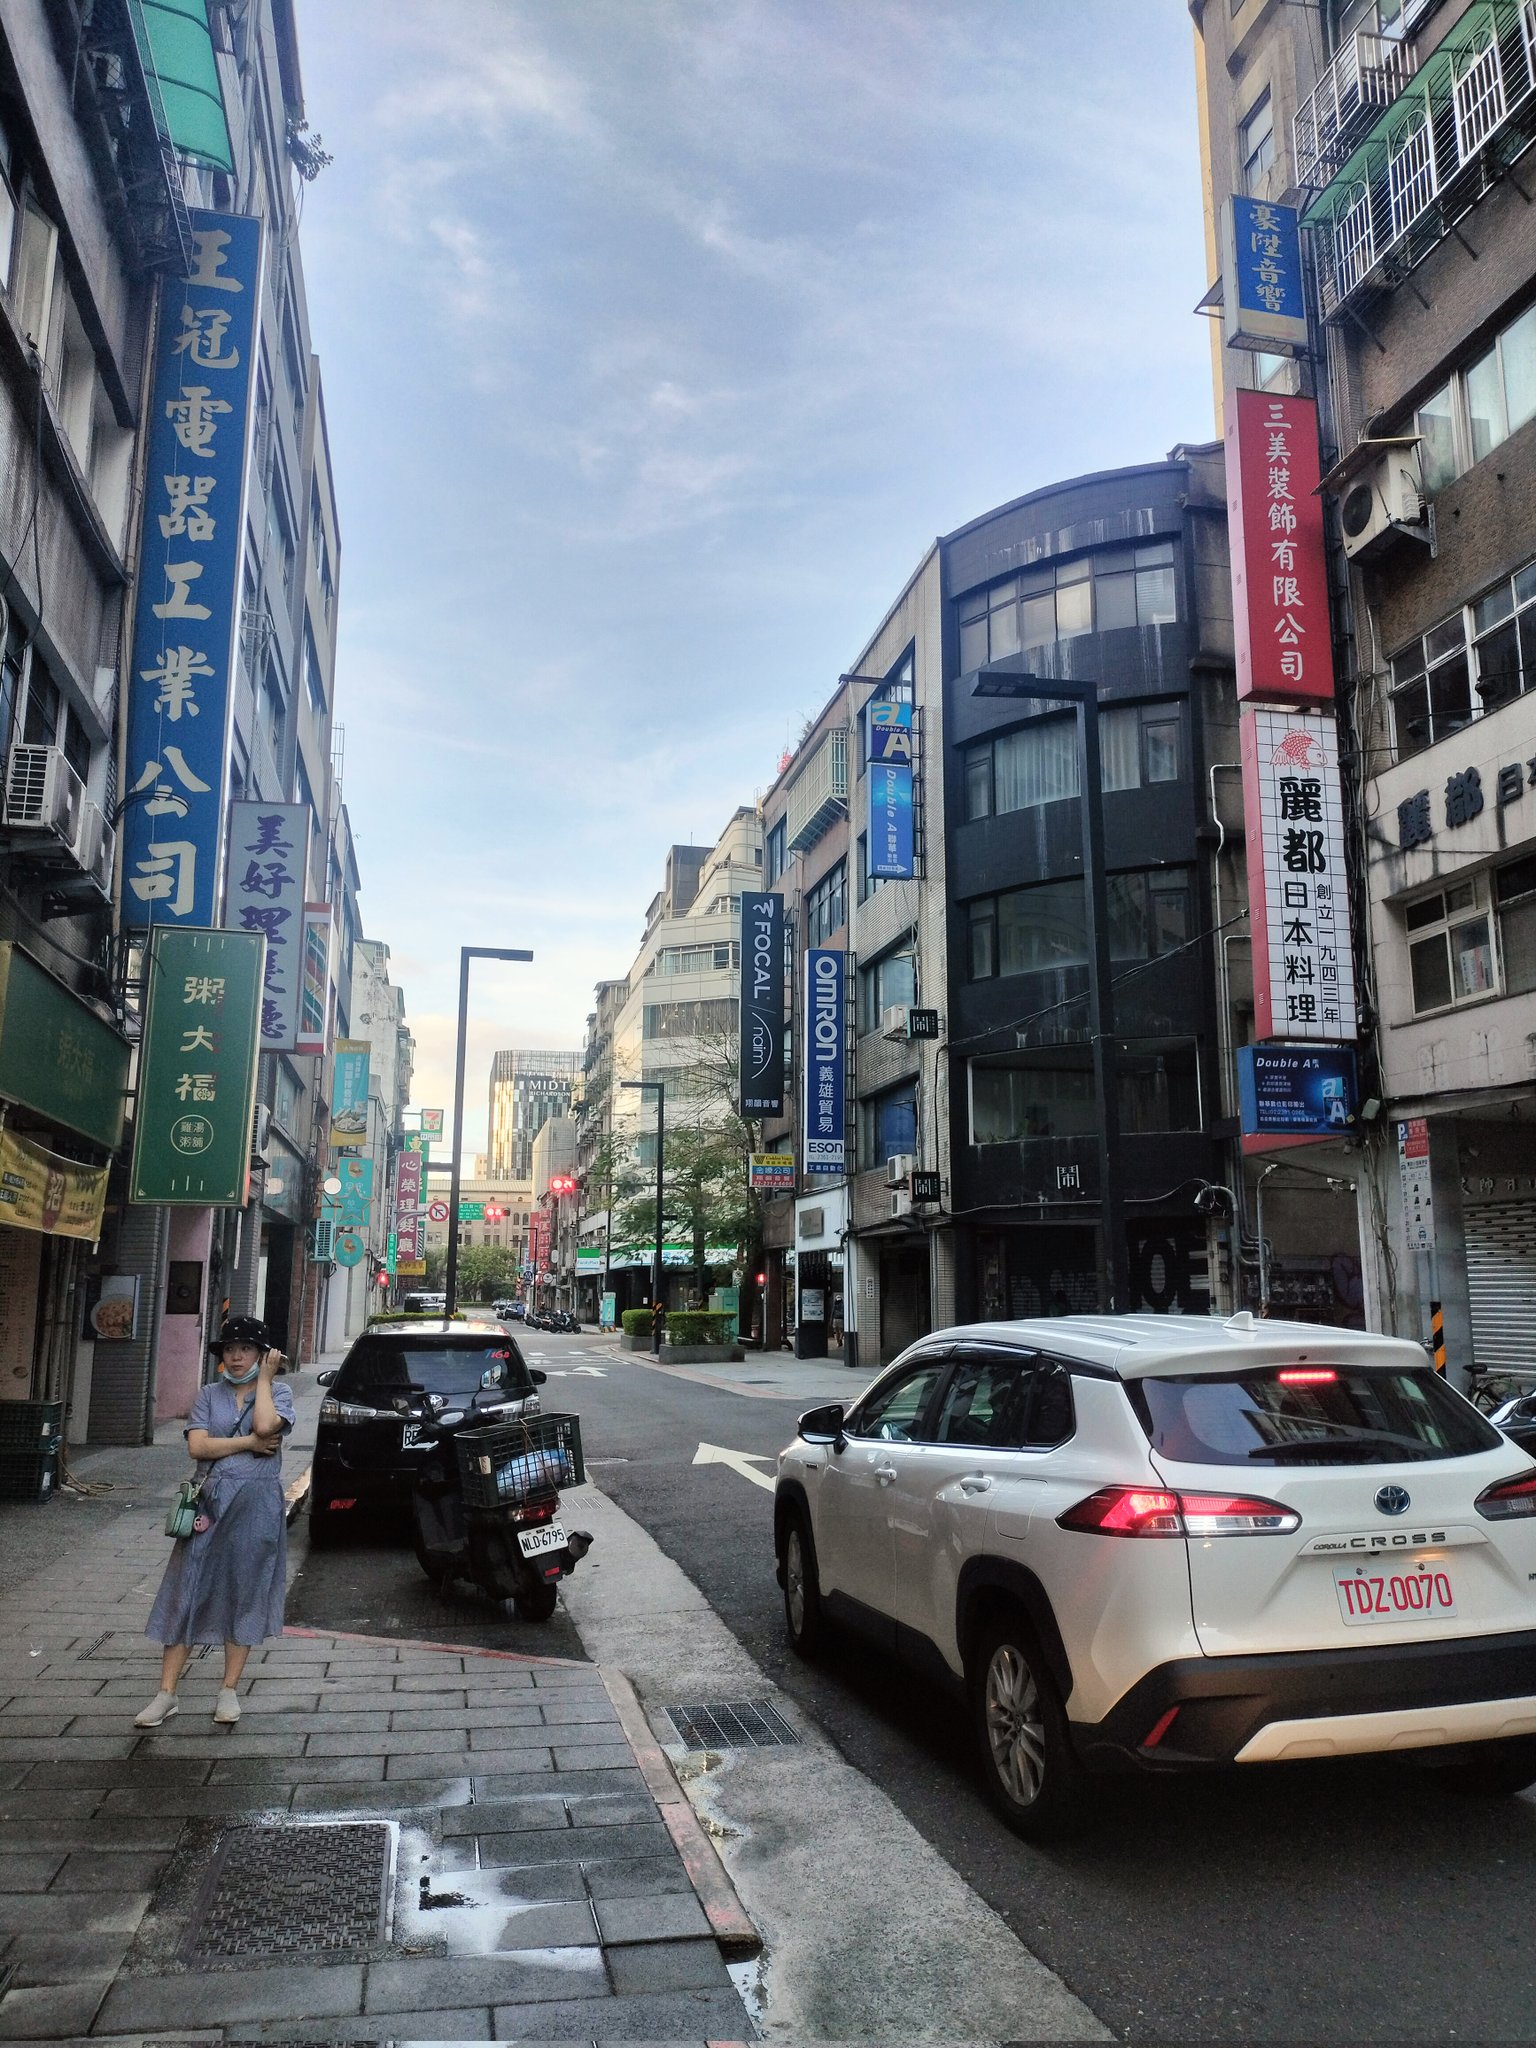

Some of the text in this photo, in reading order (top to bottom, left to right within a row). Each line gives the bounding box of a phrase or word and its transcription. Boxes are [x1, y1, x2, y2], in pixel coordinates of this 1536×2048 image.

[1263, 402, 1306, 682] 三美裝飾有限公司
[886, 769, 898, 832] Double A
[1279, 776, 1327, 1024] 麗都日本料理
[754, 921, 771, 999] FOCAL
[1316, 883, 1340, 1024] 創立一九四三年
[174, 976, 226, 1102] 粥大福
[752, 1026, 767, 1065] naim
[1256, 1057, 1299, 1068] Double
[1302, 1059, 1311, 1069] A
[818, 1065, 834, 1133] 義雄貿易
[1056, 1164, 1080, 1190] 鬧
[1350, 1532, 1447, 1548] CROSS
[1338, 1573, 1453, 1615] TDZ-0070
